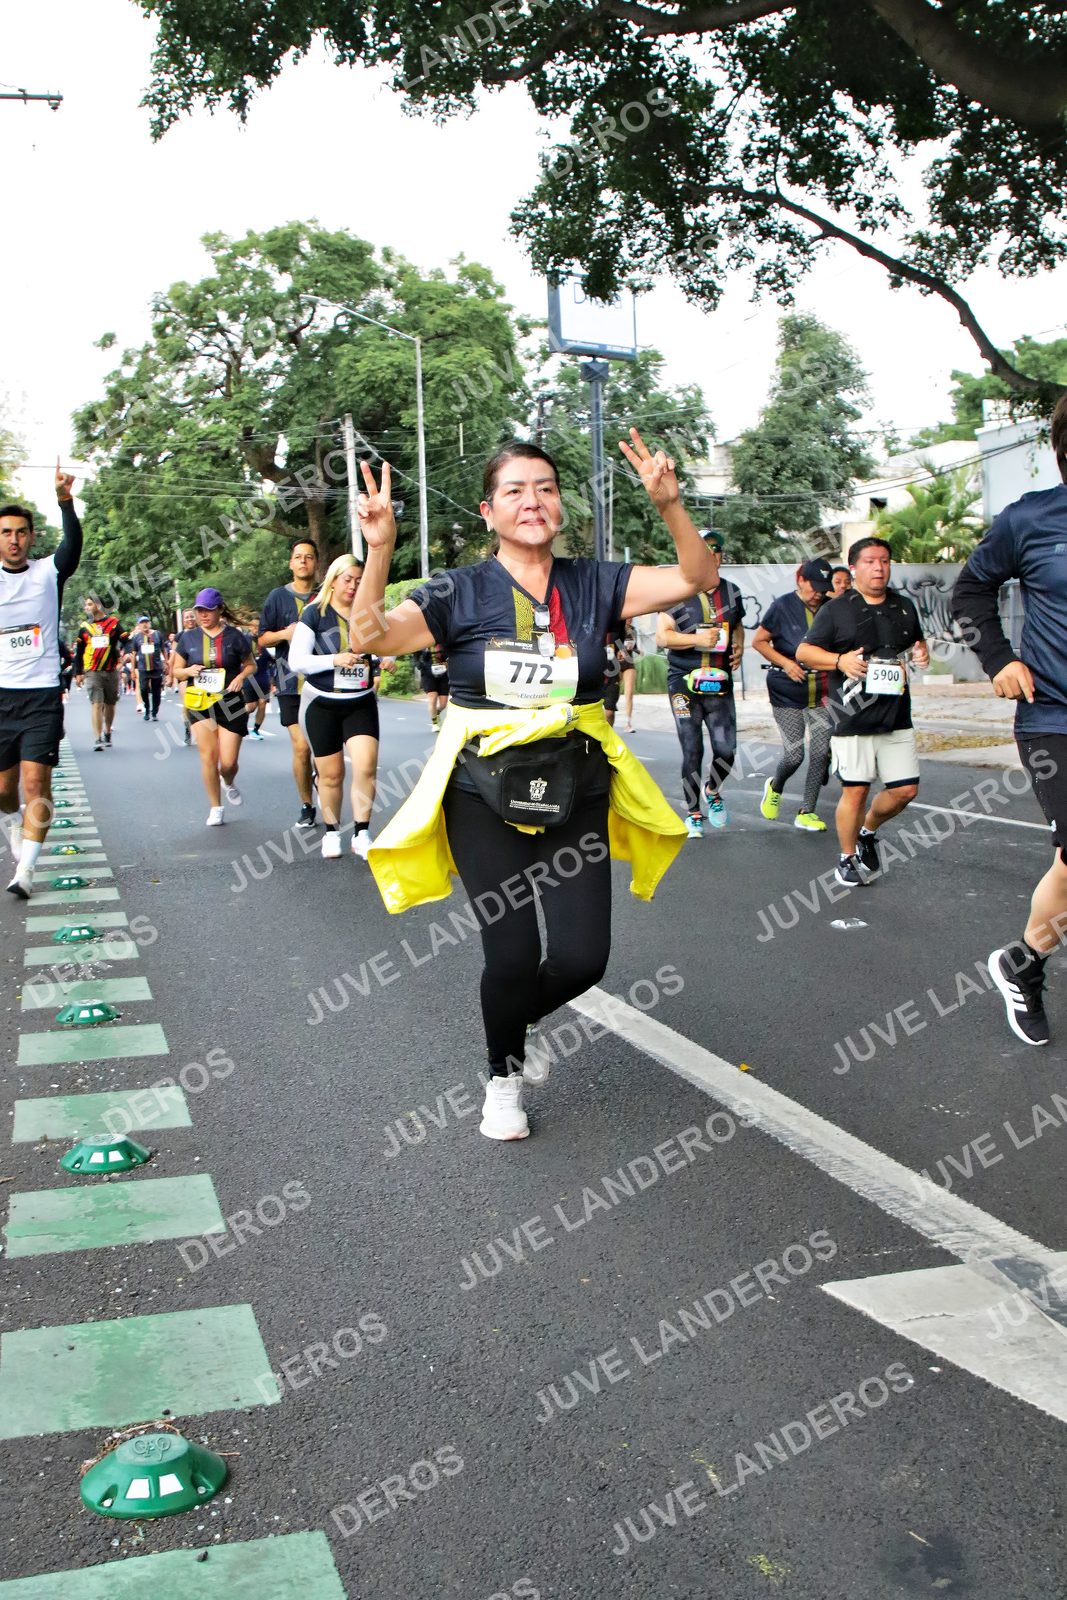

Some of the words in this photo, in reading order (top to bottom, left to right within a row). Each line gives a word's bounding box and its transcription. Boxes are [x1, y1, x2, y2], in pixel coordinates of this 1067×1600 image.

[11, 635, 32, 648] 806
[340, 667, 364, 678] 4448
[509, 660, 553, 685] 772
[873, 669, 900, 682] 5900
